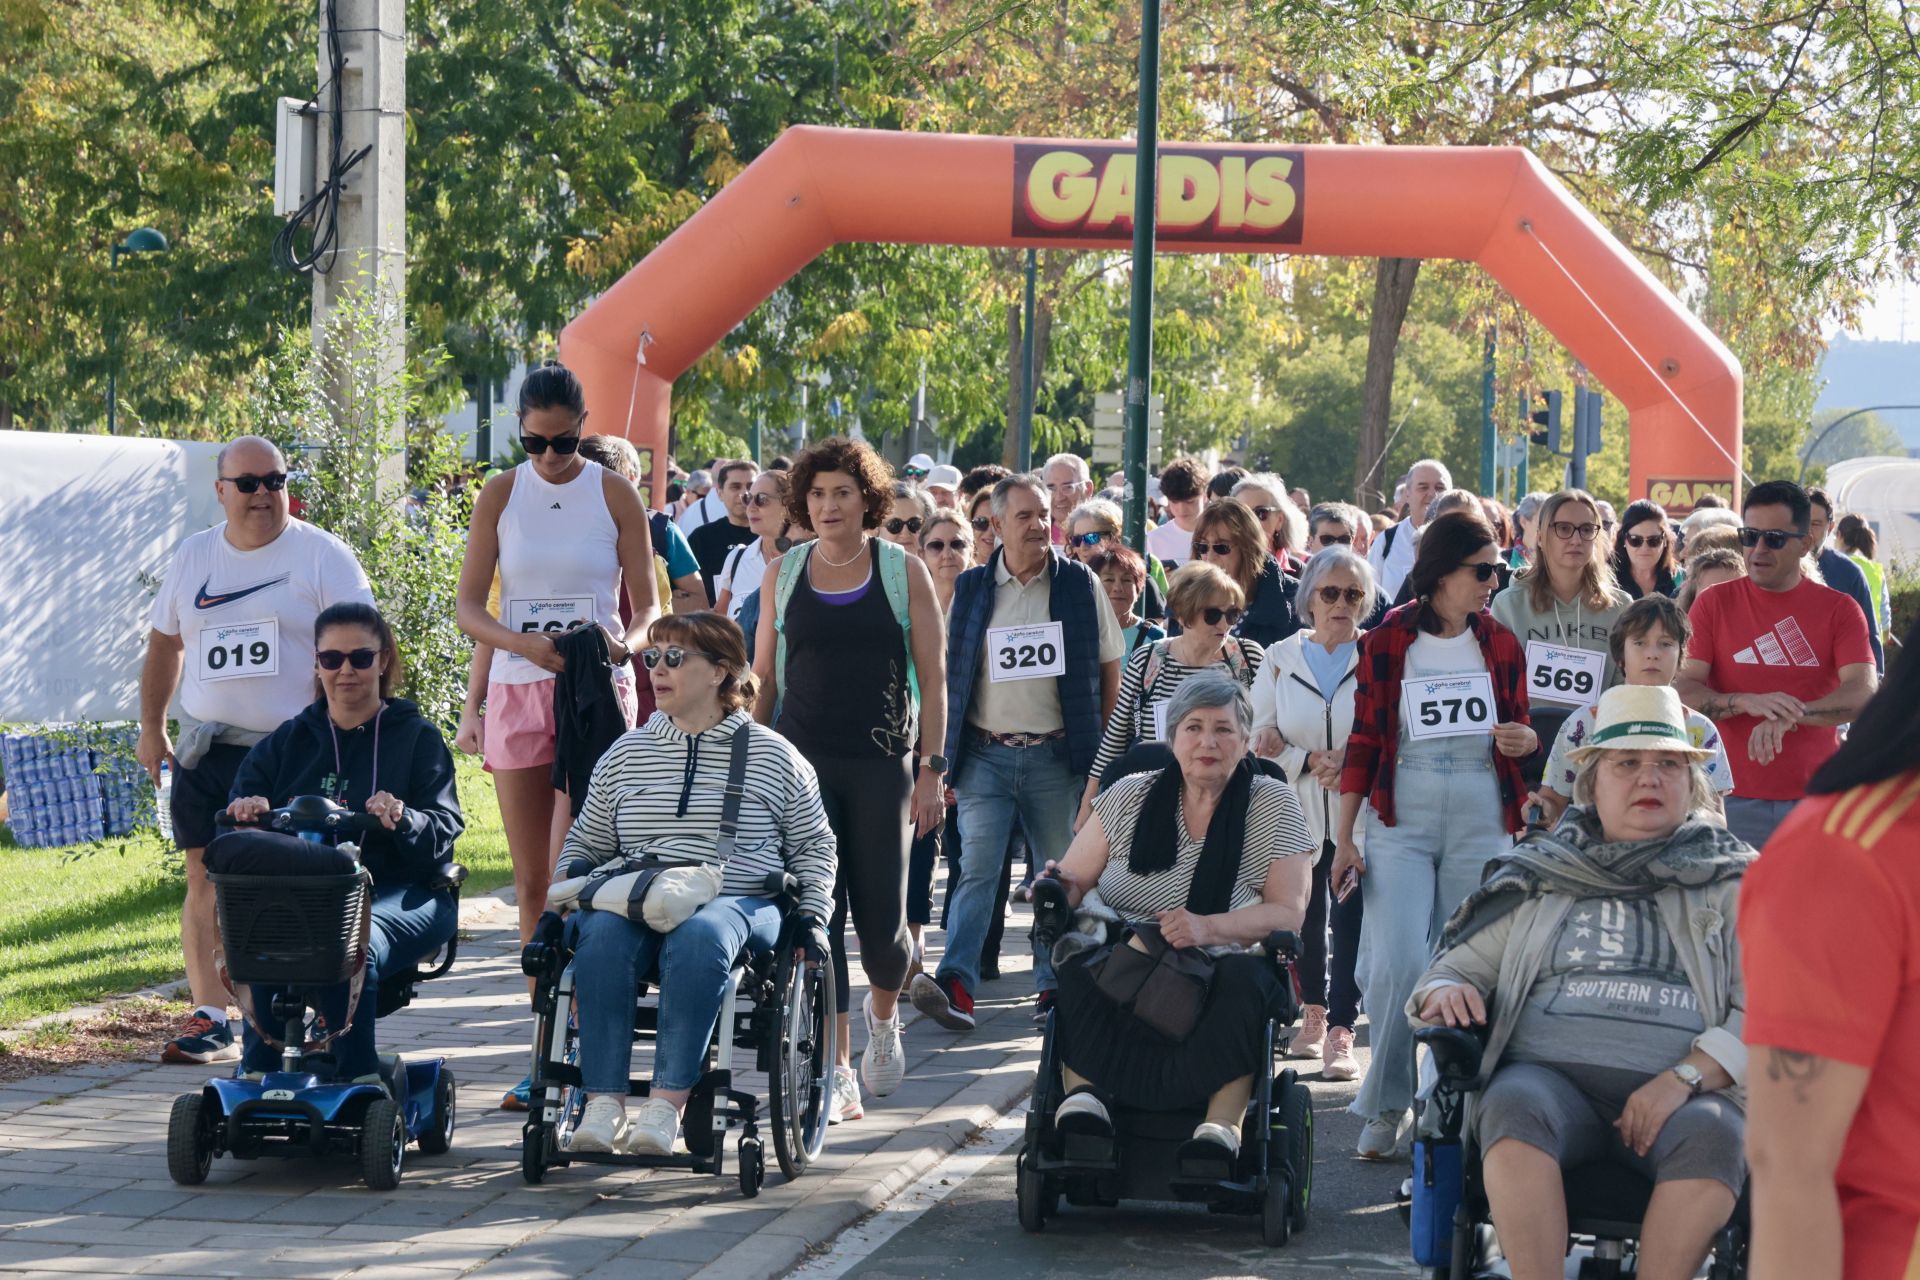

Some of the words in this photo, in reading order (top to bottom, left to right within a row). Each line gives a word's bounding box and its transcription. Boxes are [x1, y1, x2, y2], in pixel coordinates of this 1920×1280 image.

[1025, 151, 1296, 231] GADIS
[207, 641, 270, 670] 019
[1000, 643, 1056, 670] 320
[1532, 664, 1594, 695] 569
[1420, 696, 1488, 726] 570
[1566, 980, 1651, 1004] SOUTHERN
